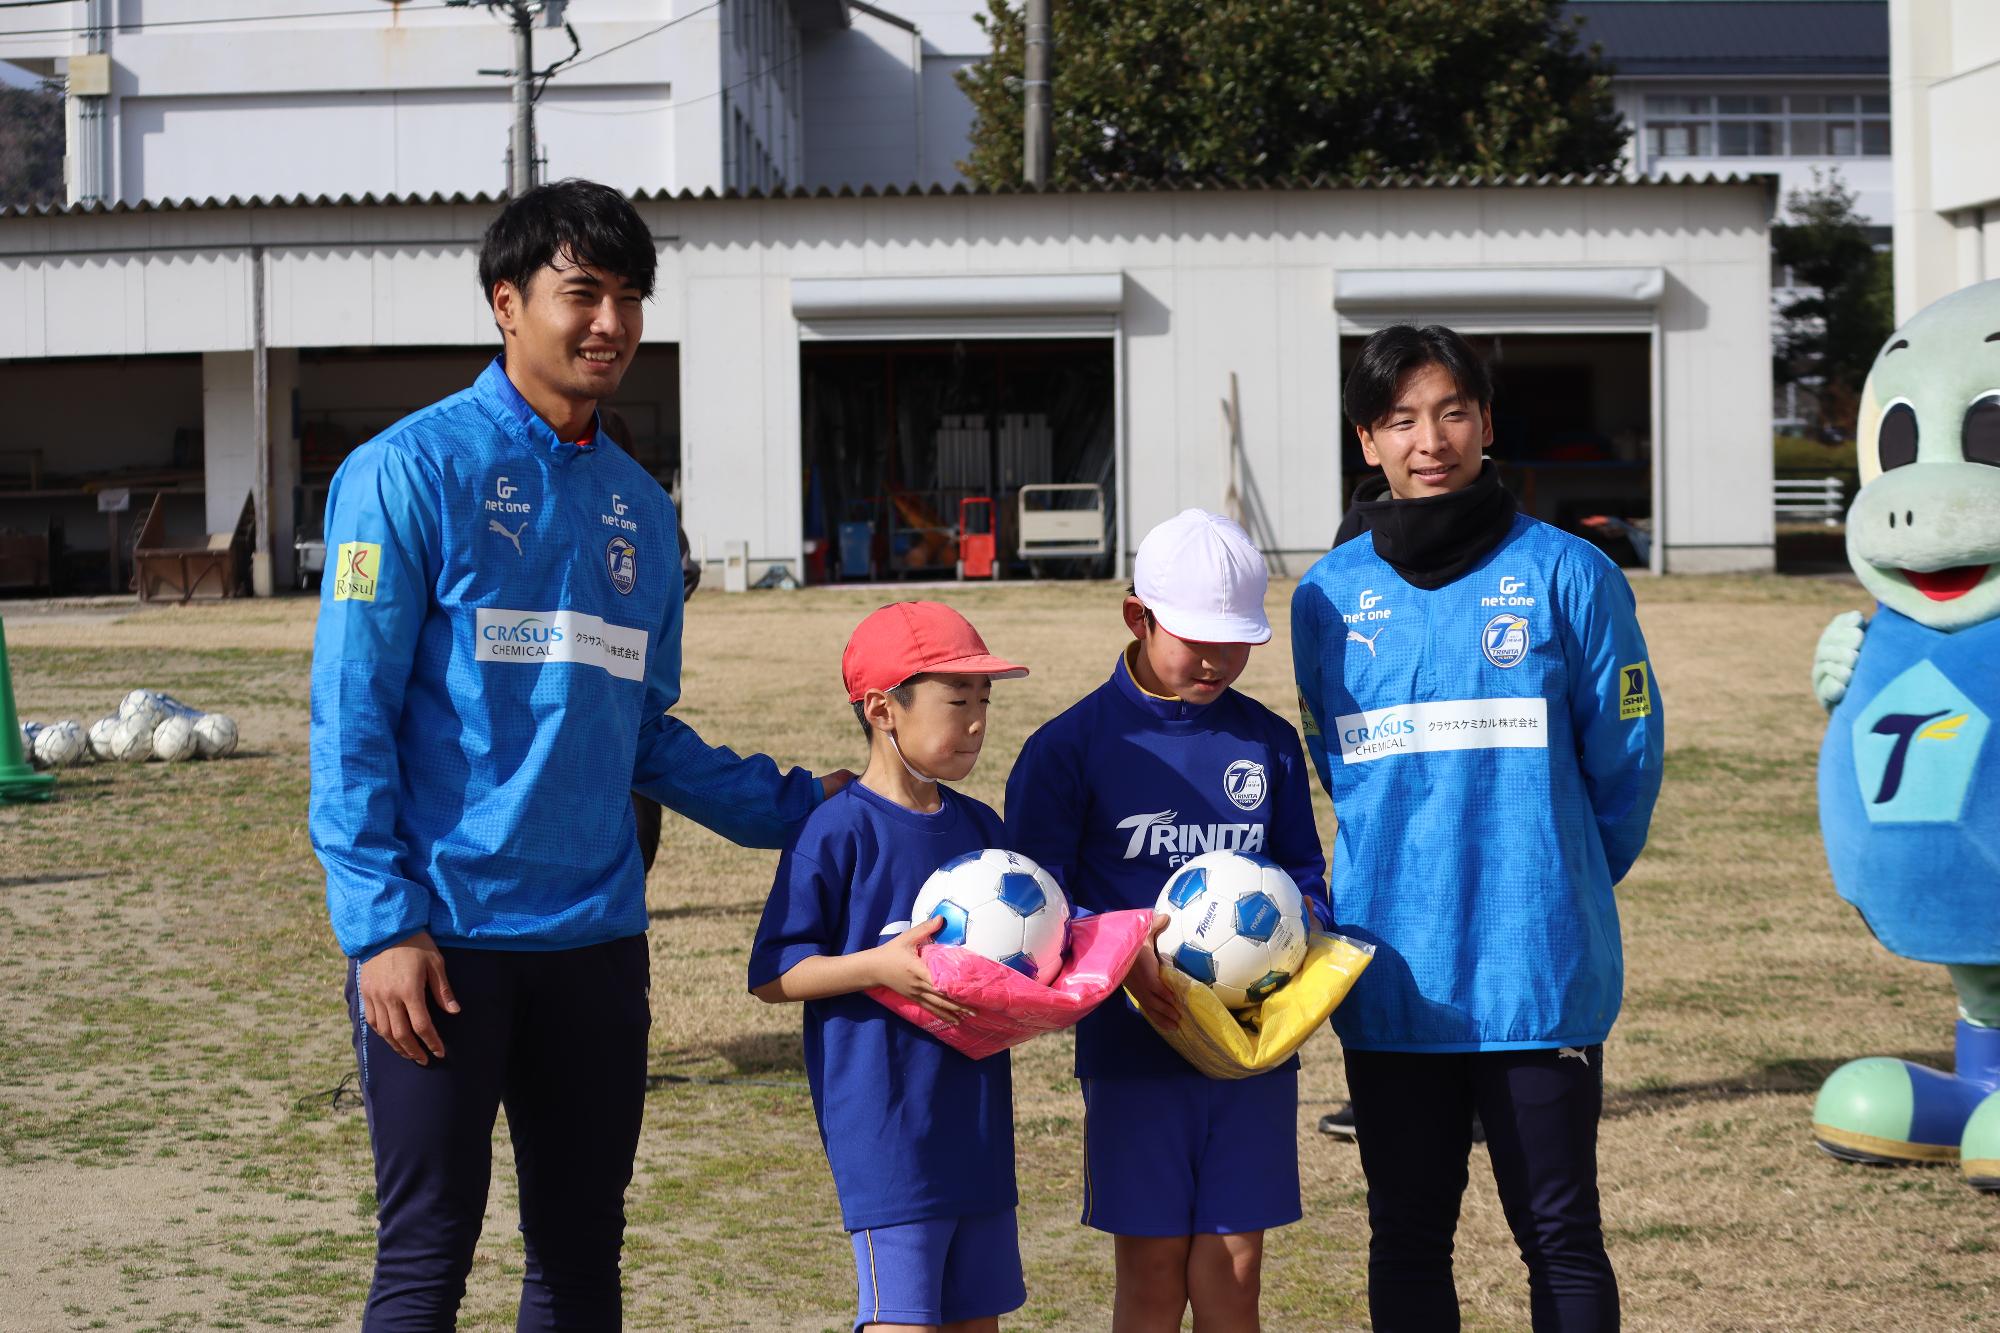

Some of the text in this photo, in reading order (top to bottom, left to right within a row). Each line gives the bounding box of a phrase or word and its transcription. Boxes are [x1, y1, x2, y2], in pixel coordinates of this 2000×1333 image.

[484, 499, 531, 513] net one
[602, 514, 637, 532] net one
[1481, 595, 1535, 607] net one
[1343, 609, 1391, 624] net one
[483, 621, 564, 643] CRASUS
[491, 644, 555, 657] CHEMICAL
[1344, 719, 1415, 744] CRASUS
[1428, 718, 1538, 732] クラサスケミカル株式会社
[1355, 738, 1406, 756] CHEMICAL
[1116, 809, 1265, 859] TRINITA
[1195, 900, 1219, 939] TRINITA
[1250, 903, 1269, 932] molten
